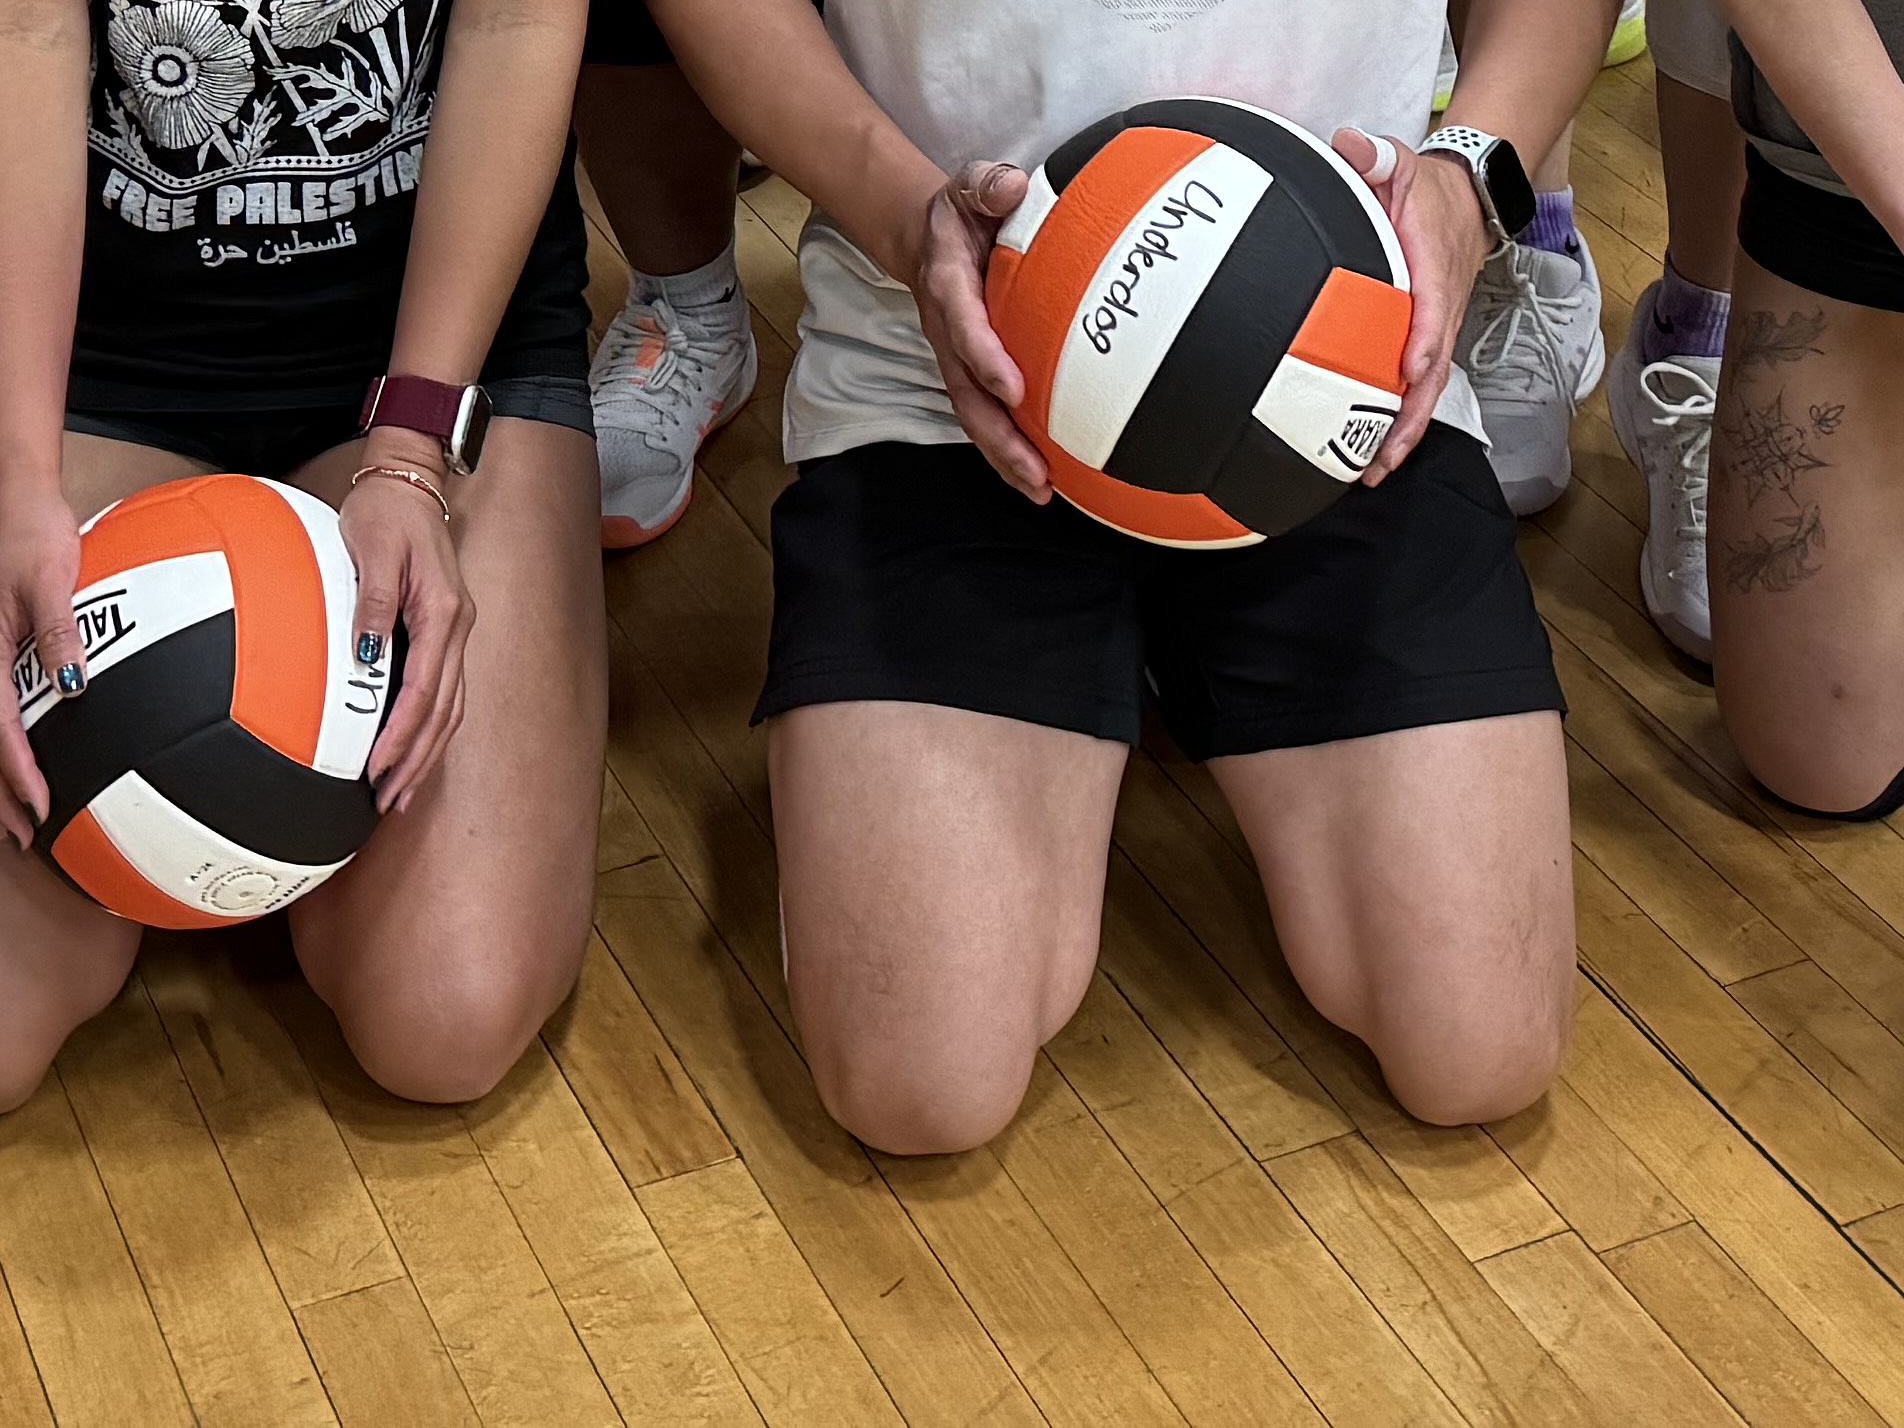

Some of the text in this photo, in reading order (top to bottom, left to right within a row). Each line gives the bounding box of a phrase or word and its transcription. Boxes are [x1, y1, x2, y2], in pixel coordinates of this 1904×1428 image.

[102, 142, 424, 232] FREE PALESTIN
[196, 220, 357, 267] حرة فلسطين
[1082, 179, 1224, 355] Underdog
